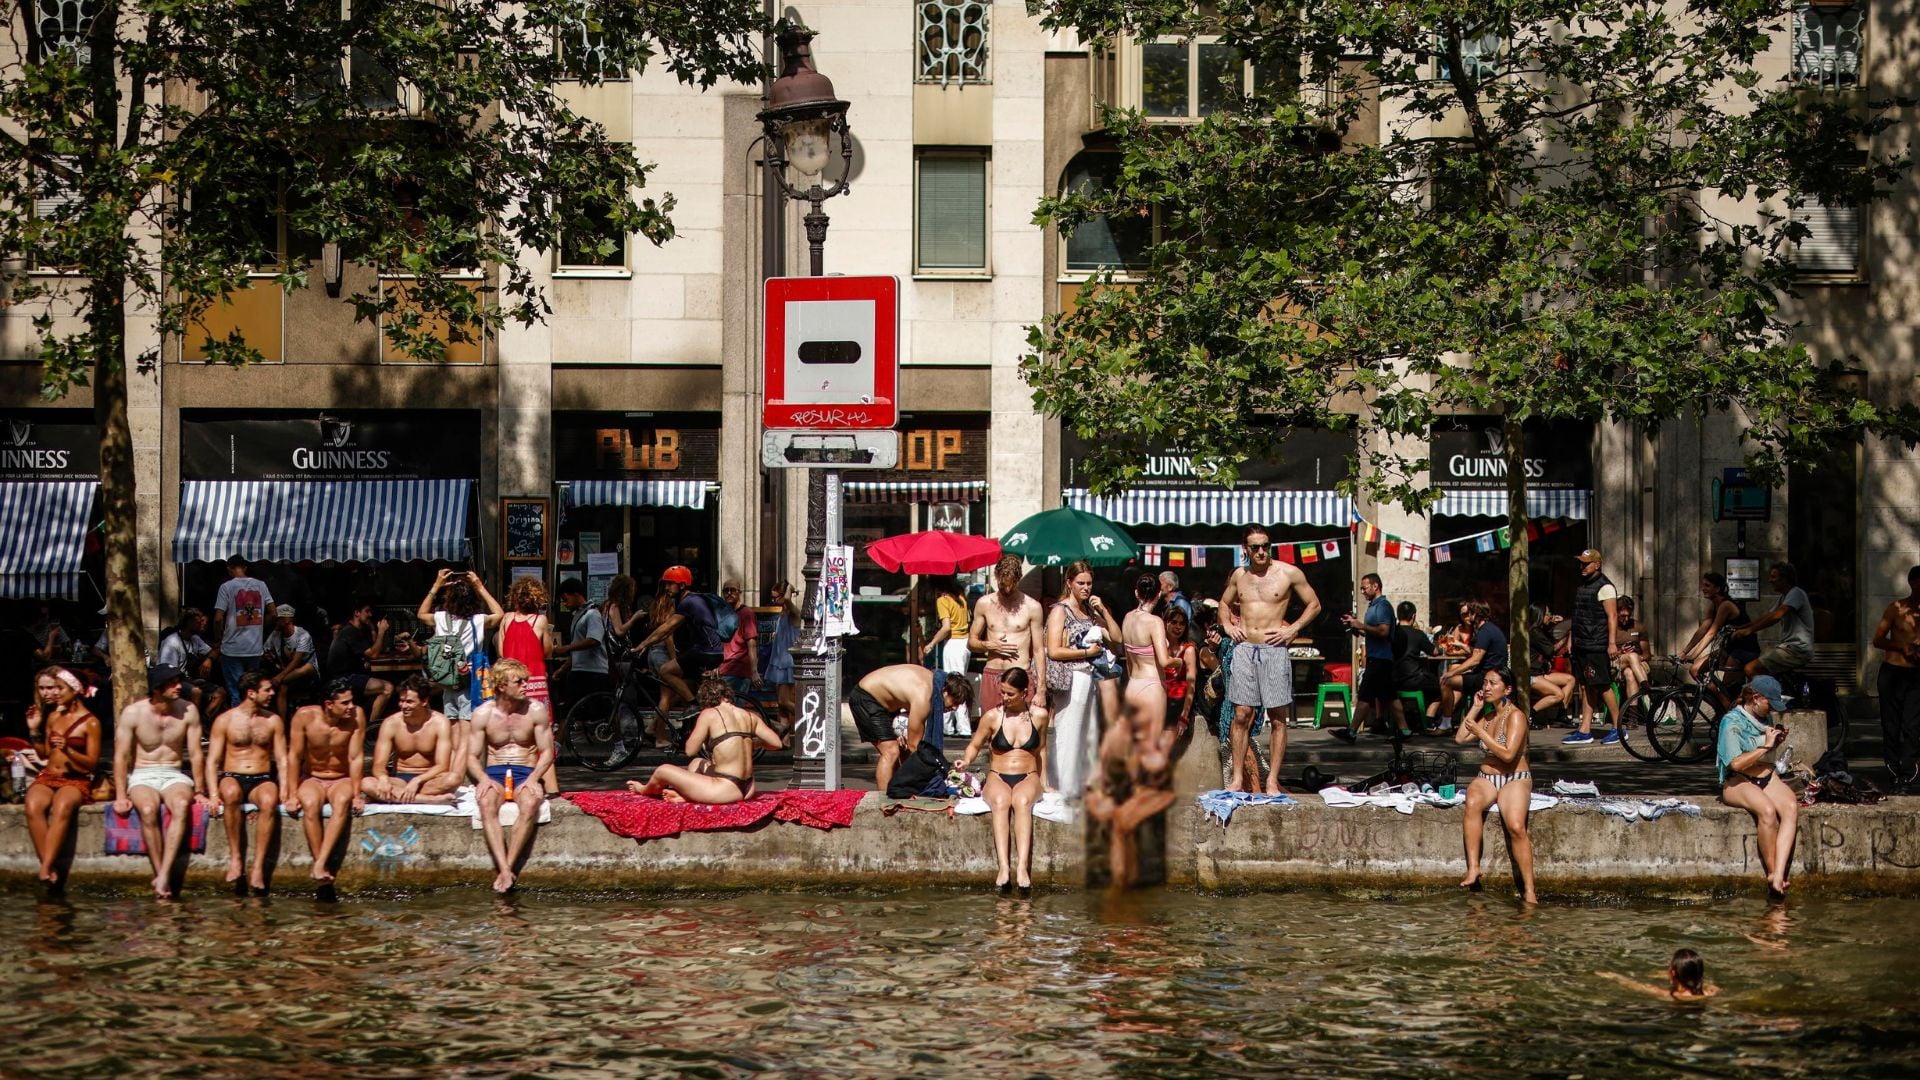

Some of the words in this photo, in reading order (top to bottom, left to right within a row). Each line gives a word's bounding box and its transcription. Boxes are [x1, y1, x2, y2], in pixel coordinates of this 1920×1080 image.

[1, 449, 68, 469] INNESS
[292, 447, 388, 469] GUINNESS
[596, 428, 679, 469] PUB
[896, 429, 961, 470] OP
[1448, 454, 1544, 477] GUINNSS
[507, 513, 544, 528] Original
